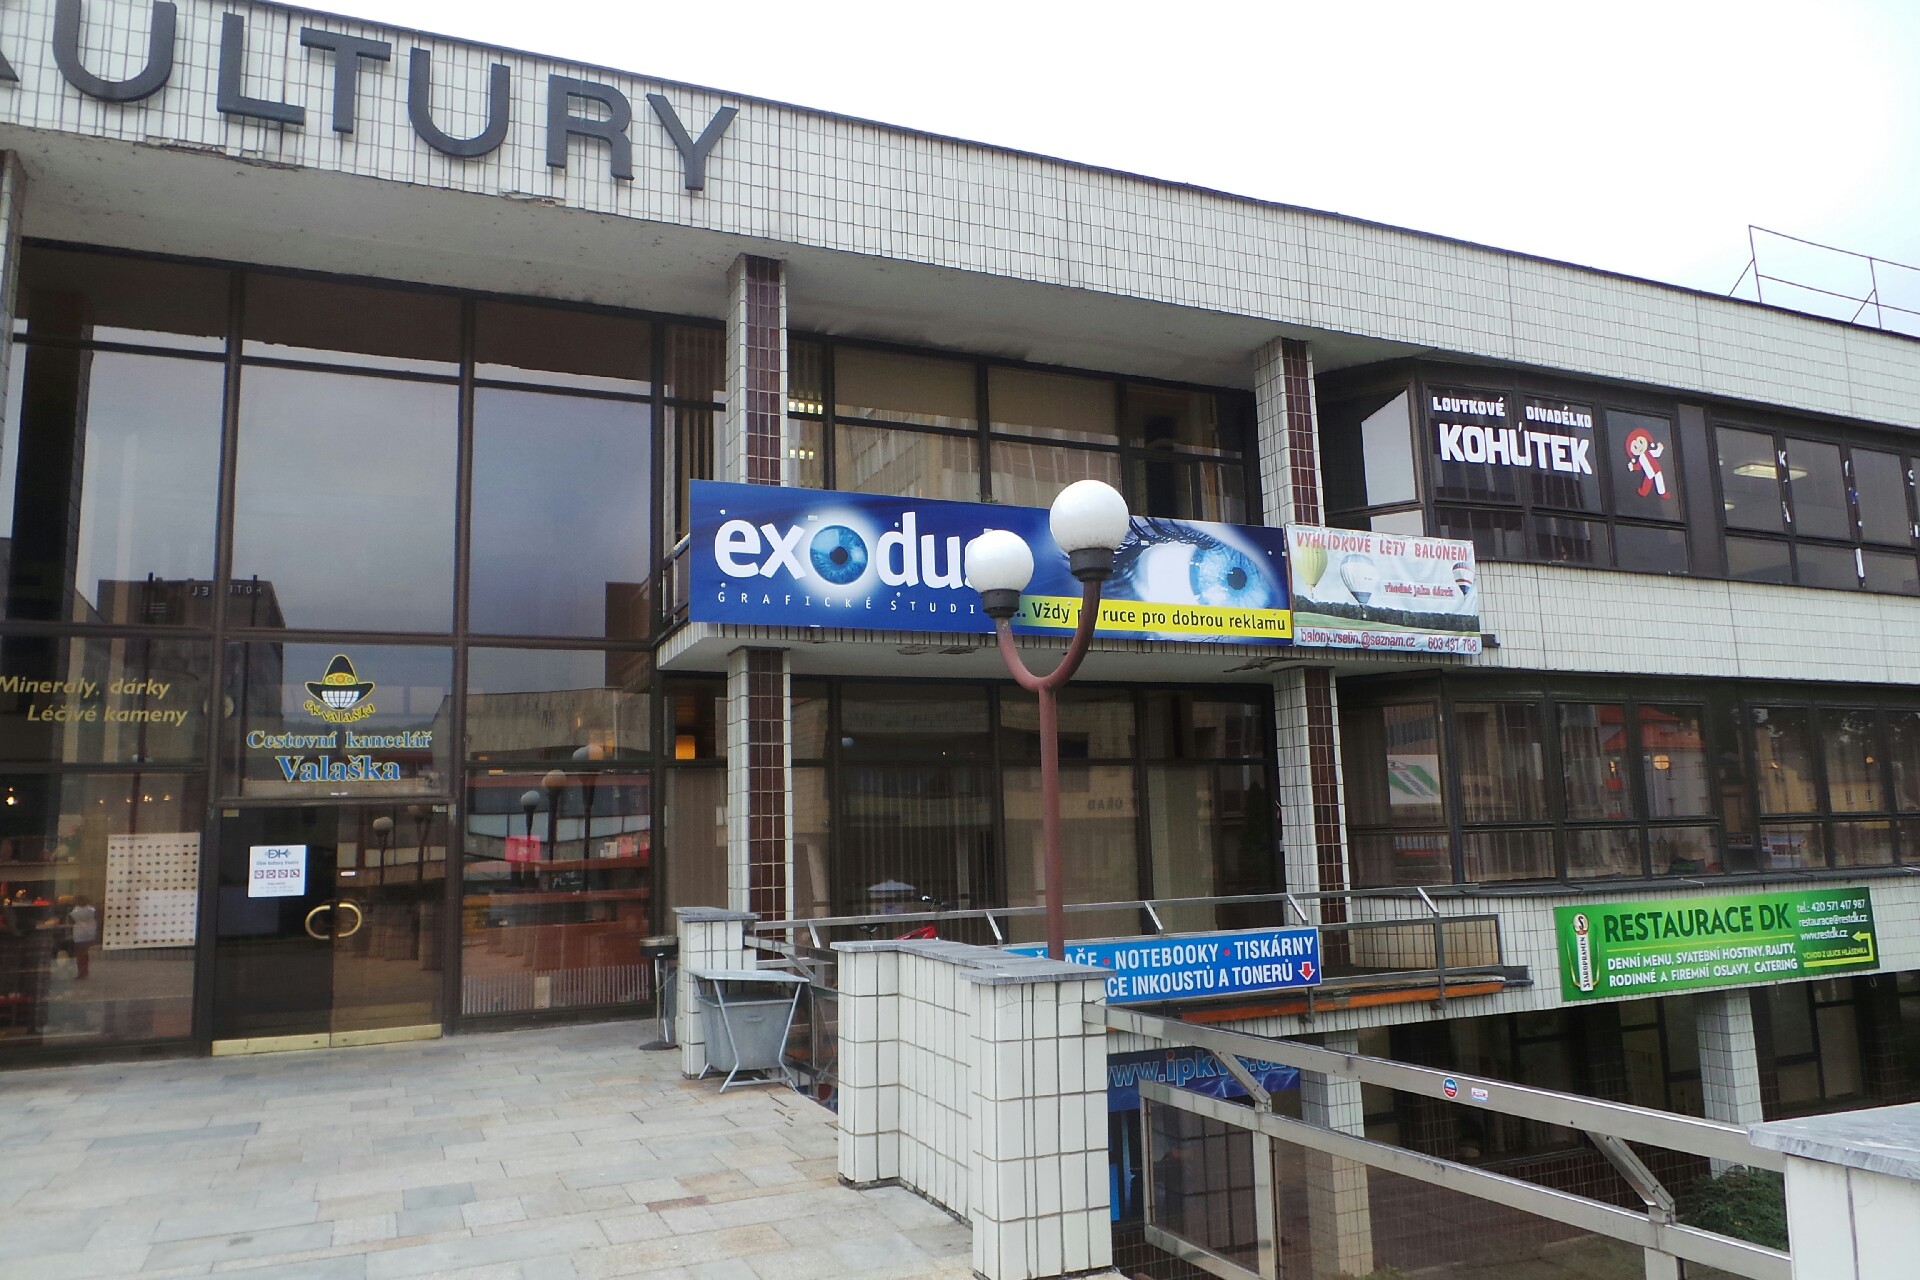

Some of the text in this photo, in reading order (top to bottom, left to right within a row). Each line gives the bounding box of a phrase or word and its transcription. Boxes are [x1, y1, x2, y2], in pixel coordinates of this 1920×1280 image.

[0, 0, 739, 191] ULTURY
[1432, 396, 1592, 428] LOUTKOVÉ DIVADÉLKO
[1438, 422, 1593, 475] KOHÚTEK
[714, 511, 976, 590] exodu
[1296, 530, 1371, 554] VYHLÍDKOVÉ
[1380, 539, 1406, 557] LETY
[718, 591, 976, 614] GRAFICKÉ STUDI
[1031, 602, 1070, 624] Vždy
[1102, 609, 1136, 623] ruce
[1142, 611, 1166, 628] pro
[1172, 609, 1223, 628] dobrou
[1229, 614, 1287, 631] reklamu
[1427, 636, 1443, 651] 603
[1445, 637, 1459, 651] 437
[109, 677, 171, 700] dárky
[27, 704, 188, 727] Léčivé kameny
[246, 730, 433, 749] Cestovní kancelář
[274, 754, 401, 782] Valaška
[1603, 902, 1792, 943] RESTAURACE DK
[1115, 943, 1219, 970] NOTEBOOKY
[1233, 934, 1314, 961] TISKÁRNY
[1608, 952, 1641, 971] DENNÍ
[1642, 953, 1675, 969] MENU,
[1676, 948, 1721, 965] SVATEBNÍ
[1765, 942, 1796, 957] RAUTY,
[1104, 958, 1293, 998] CE INKOUSTŮ A TONERŮ
[1609, 958, 1798, 987] RODINNÉ A FIREMNÍ OSLAVY, CATERING
